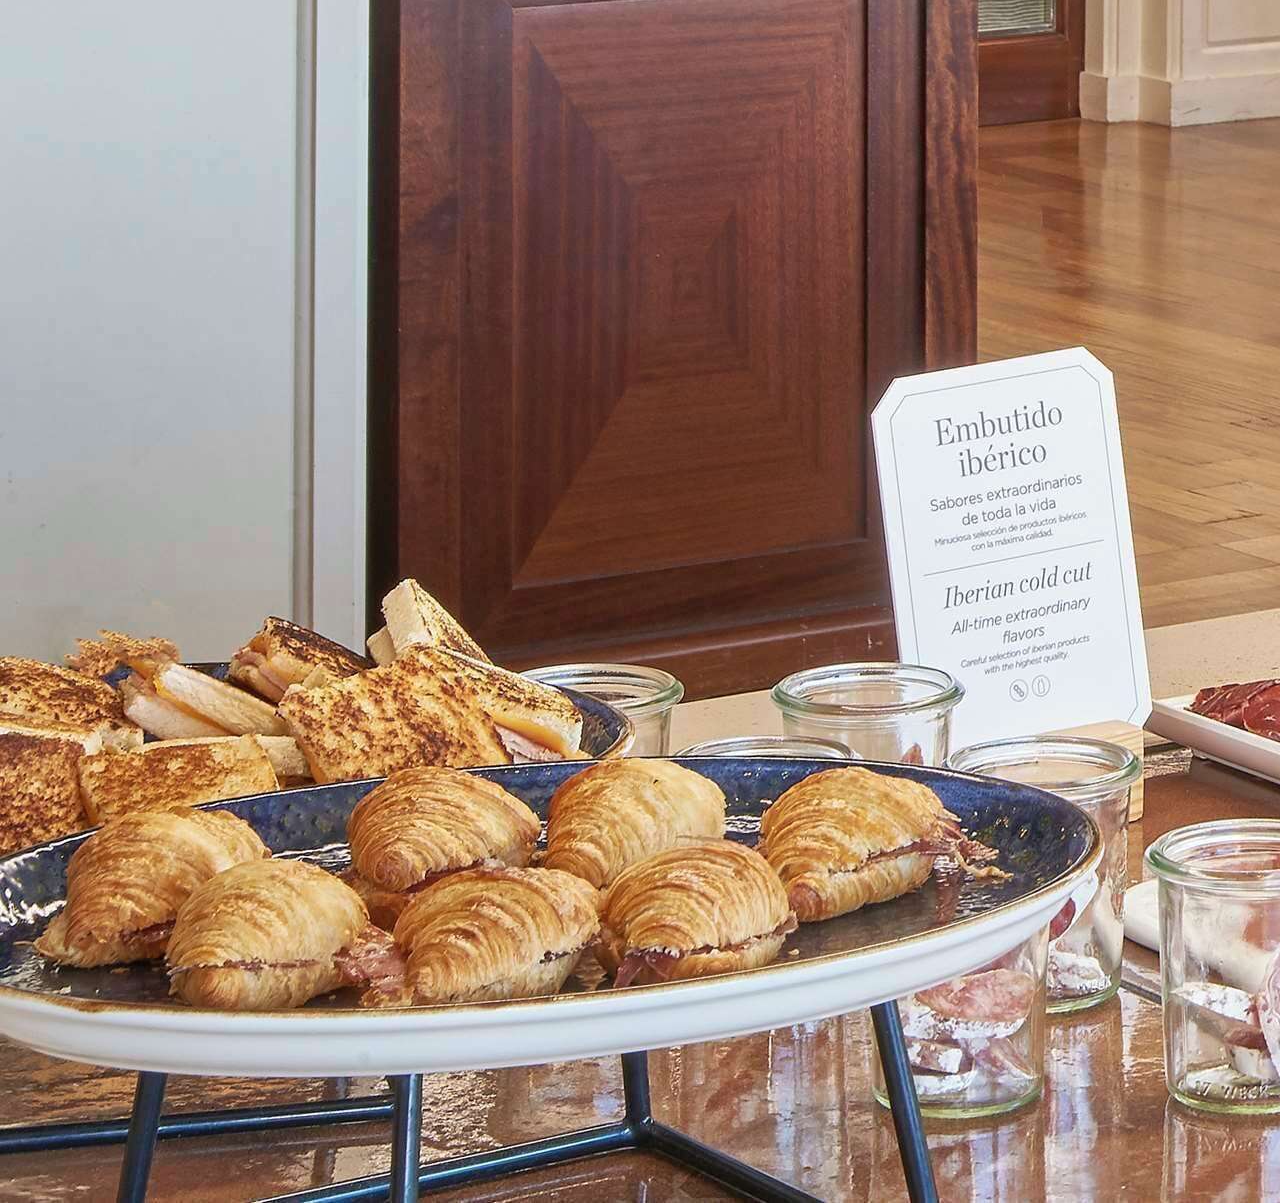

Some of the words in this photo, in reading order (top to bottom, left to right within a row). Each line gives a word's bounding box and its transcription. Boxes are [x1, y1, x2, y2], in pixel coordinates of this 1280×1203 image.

[933, 400, 1062, 447] Embutido
[957, 443, 1046, 477] ibérico
[930, 493, 983, 511] Sabores
[986, 473, 1082, 501] extraordinarios
[934, 533, 971, 546] Minuciosa
[972, 525, 1007, 539] selección
[1008, 524, 1018, 533] de
[1019, 516, 1057, 531] productos
[1058, 511, 1087, 523] ibéricos
[961, 513, 978, 526] de
[982, 506, 1012, 522] toda
[1015, 503, 1026, 516] la
[1029, 497, 1056, 513] vida
[971, 543, 985, 552] con
[986, 539, 993, 548] la
[995, 534, 1024, 546] máxima
[943, 579, 1014, 609] Iberian
[1019, 565, 1059, 593] cold
[1063, 562, 1092, 584] cut
[951, 615, 1002, 635] All-time
[1005, 597, 1091, 624] extraordinary
[960, 655, 988, 668] Careful
[988, 649, 1021, 662] selection
[1022, 646, 1031, 655] of
[1057, 635, 1090, 649] products
[1002, 626, 1045, 644] flavors
[984, 665, 1000, 675] with
[1001, 663, 1014, 671] the
[1015, 657, 1042, 669] highest
